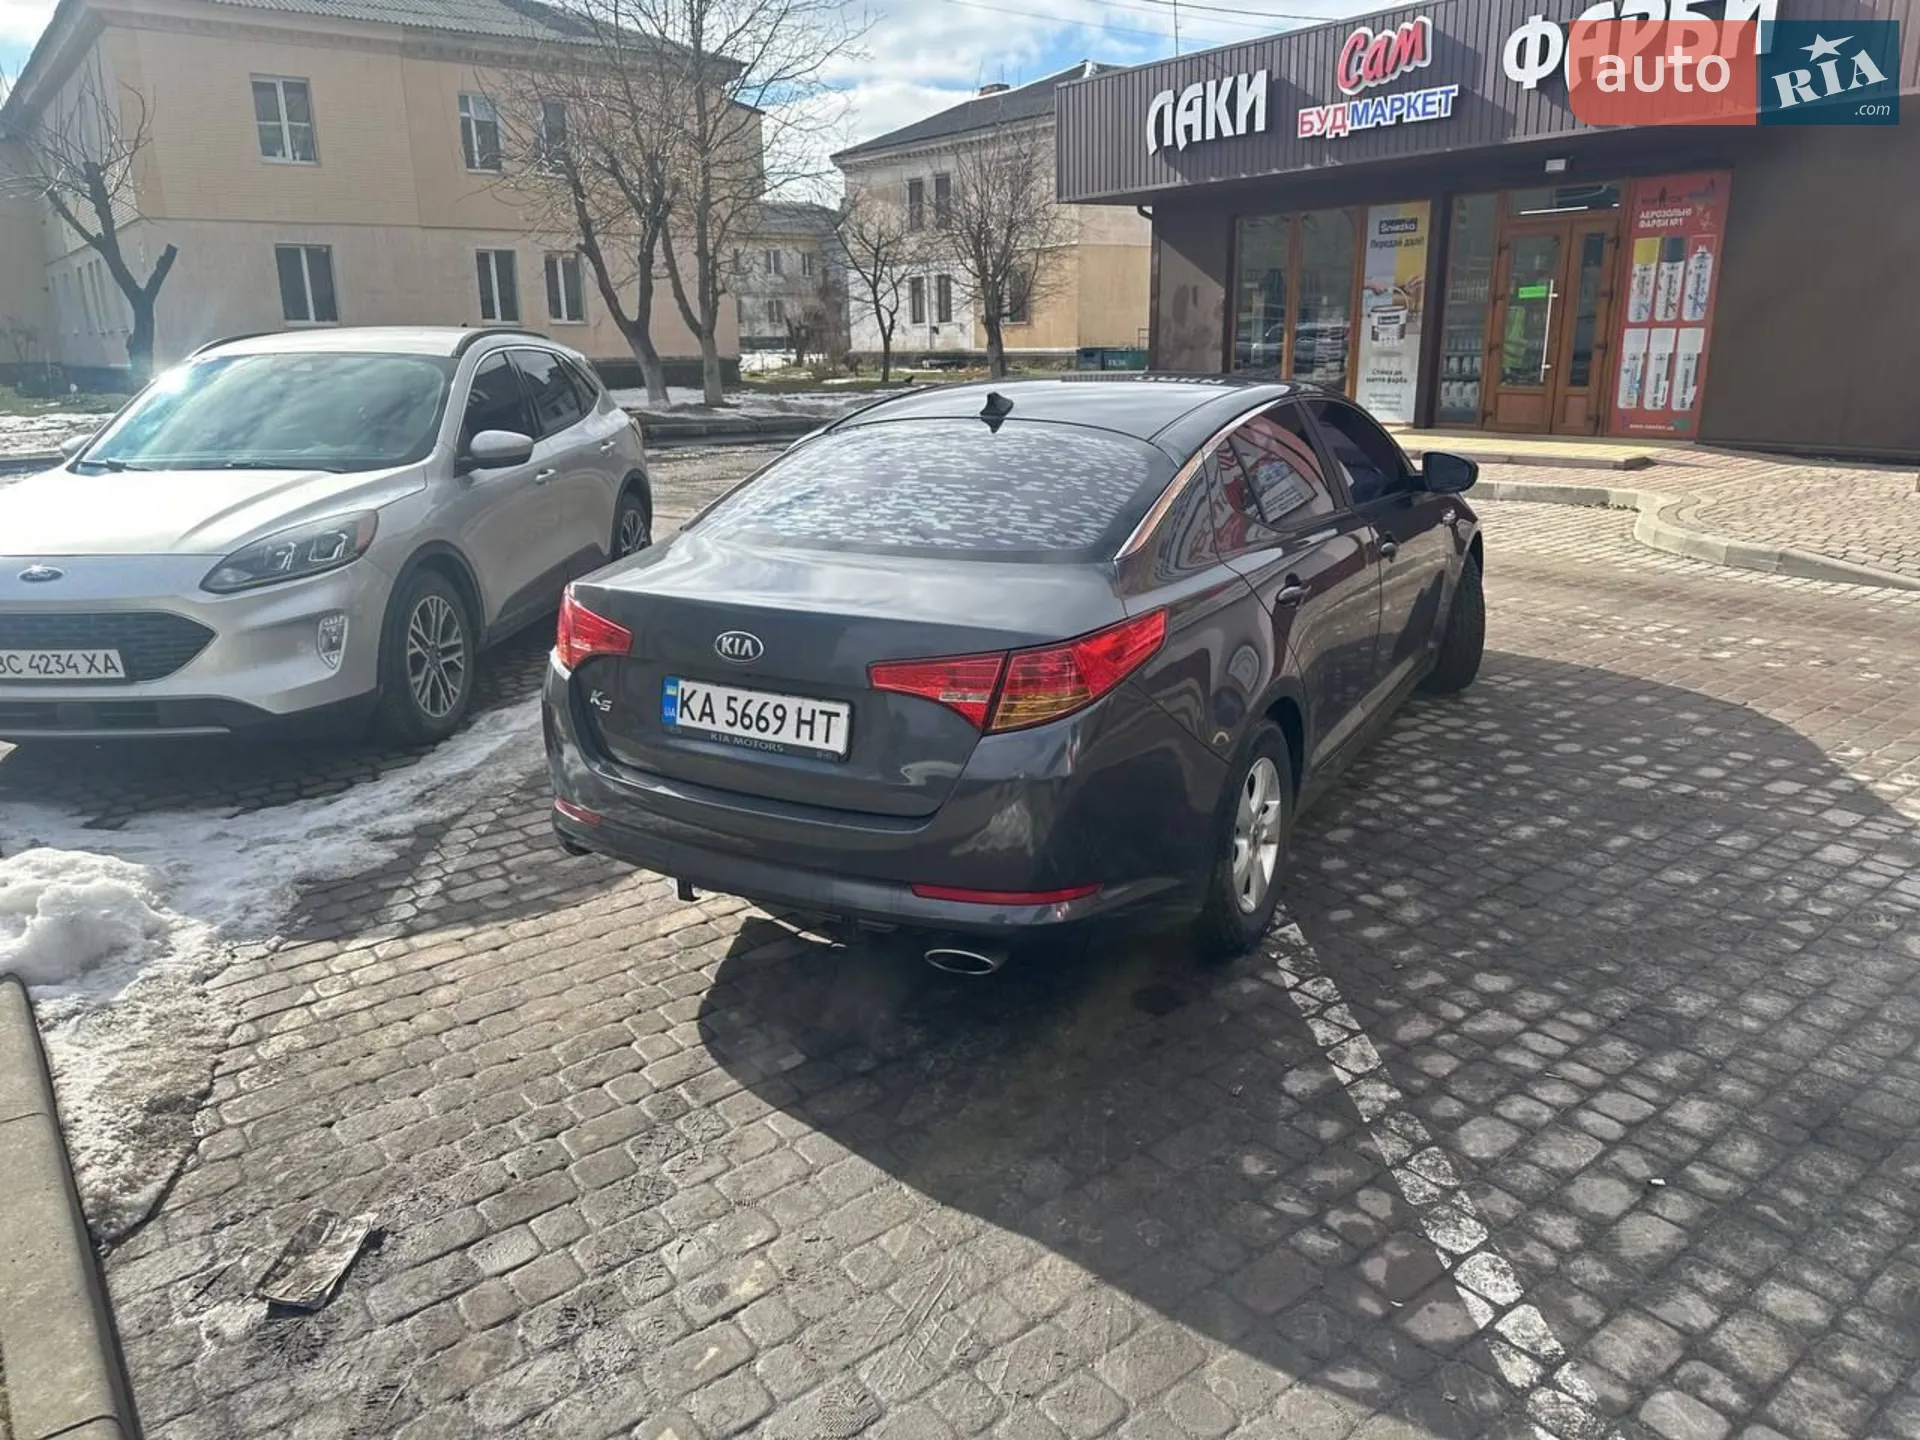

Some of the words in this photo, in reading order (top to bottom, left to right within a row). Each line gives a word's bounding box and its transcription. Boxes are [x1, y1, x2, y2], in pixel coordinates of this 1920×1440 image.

[1337, 16, 1432, 94] Сам
[1146, 69, 1267, 156] ЛАКИ
[1297, 84, 1459, 139] БУДМАРКЕТ
[28, 654, 79, 675] 4234
[82, 653, 119, 674] XA
[721, 637, 754, 656] KIA
[679, 687, 716, 725] KA
[725, 695, 788, 736] 5669
[795, 706, 841, 744] HT
[710, 733, 729, 744] KIA
[732, 737, 784, 752] MOTORS
